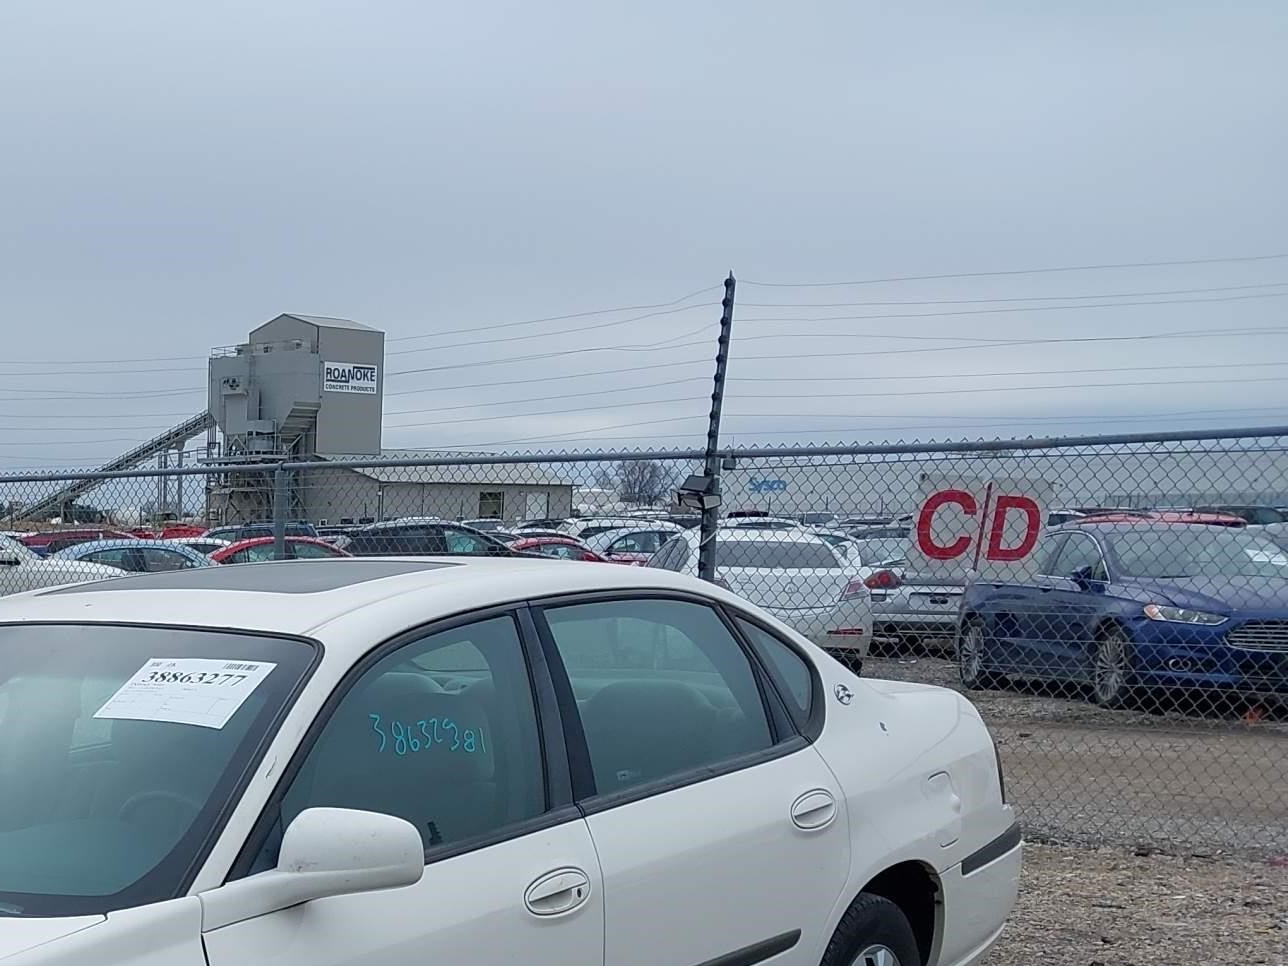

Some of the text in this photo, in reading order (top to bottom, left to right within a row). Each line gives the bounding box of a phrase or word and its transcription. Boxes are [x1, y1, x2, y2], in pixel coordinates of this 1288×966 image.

[325, 365, 376, 382] ROANOKE
[325, 383, 375, 393] CONCRETE PRODUCTS
[748, 475, 787, 494] Sysco
[141, 671, 249, 687] 38863277
